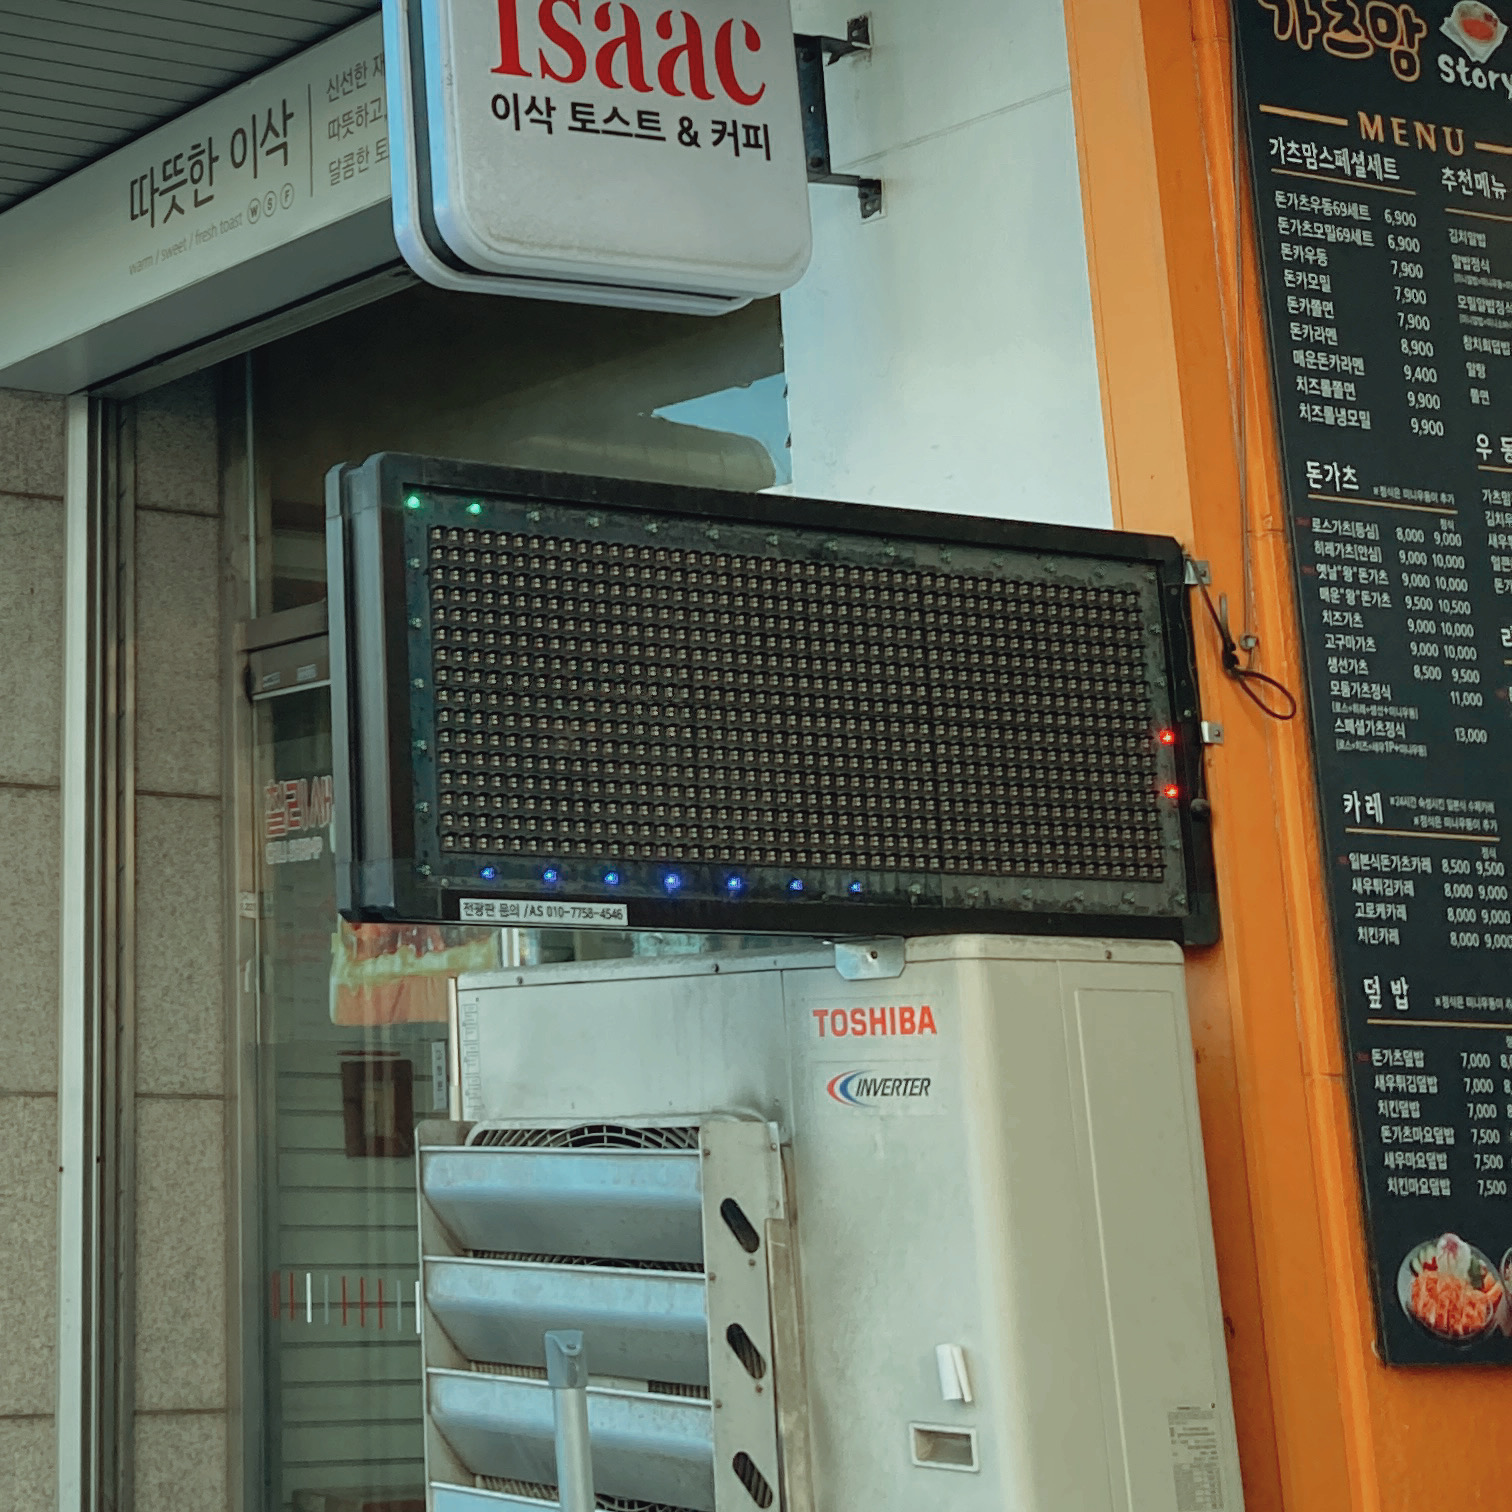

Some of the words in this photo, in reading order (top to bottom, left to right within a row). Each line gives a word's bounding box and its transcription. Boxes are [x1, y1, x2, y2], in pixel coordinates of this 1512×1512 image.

[326, 61, 368, 104] 신선한
[490, 91, 557, 135] 이삭
[567, 102, 667, 143] 토스트
[678, 116, 701, 148] &
[711, 119, 773, 162] 커피
[1357, 110, 1464, 157] MENU
[129, 136, 220, 229] 따뜻한
[230, 98, 295, 180] 이삭
[328, 147, 370, 187] 달콤한
[1268, 136, 1400, 182] 가츠맘스페셜세트
[1440, 166, 1507, 201] 추천메뉴
[1384, 208, 1418, 228] 6,900
[1387, 234, 1421, 254] 6,900
[1280, 242, 1329, 268] 돈카우동
[1390, 259, 1424, 280] 7,900
[1394, 285, 1428, 306] 7,900
[1397, 311, 1431, 332] 7,900
[1400, 337, 1435, 358] 8,900
[1403, 363, 1438, 384] 9,400
[1407, 390, 1441, 411] 9,900
[1410, 416, 1445, 437] 9,900
[1305, 460, 1360, 492] 돈가츠
[1395, 526, 1425, 544] 8,000
[1433, 530, 1463, 548] 9,000
[1398, 549, 1428, 567] 9,000
[1431, 553, 1466, 571] 10,000
[1401, 572, 1431, 589] 9,000
[1434, 575, 1469, 594] 10,000
[1404, 594, 1434, 612] 9,500
[1437, 598, 1472, 616] 10,500
[1321, 608, 1364, 629] 치즈가츠
[1407, 617, 1437, 635] 9,000
[1440, 620, 1475, 639] 10,000
[1324, 632, 1377, 653] 고구마가츠
[1409, 640, 1439, 658] 9,000
[1443, 644, 1478, 662] 10,000
[1326, 655, 1370, 676] 생선가츠
[1413, 663, 1443, 682] 8,500
[1450, 666, 1481, 685] 9,500
[1450, 689, 1483, 708] 11,000
[1453, 726, 1488, 745] 13,000
[1342, 789, 1384, 825] 카레
[1441, 858, 1471, 876] 8,500
[1475, 860, 1505, 878] 9,500
[1443, 882, 1474, 900] 8,000
[1477, 884, 1508, 902] 9,000
[463, 901, 496, 918] 전광판
[499, 902, 521, 918] 문의
[1446, 906, 1477, 925] 8,000
[1480, 908, 1511, 926] 9,000
[1357, 925, 1402, 947] 치킨카레
[1449, 930, 1481, 949] 8,000
[1483, 932, 1512, 950] 9,000
[1363, 975, 1410, 1011] 덮밥
[811, 1004, 938, 1038] TOSHIBA
[1370, 1047, 1425, 1069] 돈가츠덮밥
[1459, 1051, 1492, 1070] 7,000
[854, 1076, 932, 1099] INVERTER
[1463, 1076, 1495, 1096] 7,000
[1377, 1098, 1421, 1120] 치킨덮밥
[1466, 1102, 1498, 1121] 7,000
[1470, 1128, 1501, 1147] 7,500
[1473, 1153, 1504, 1172] 7,500
[1476, 1178, 1508, 1198] 7,500
